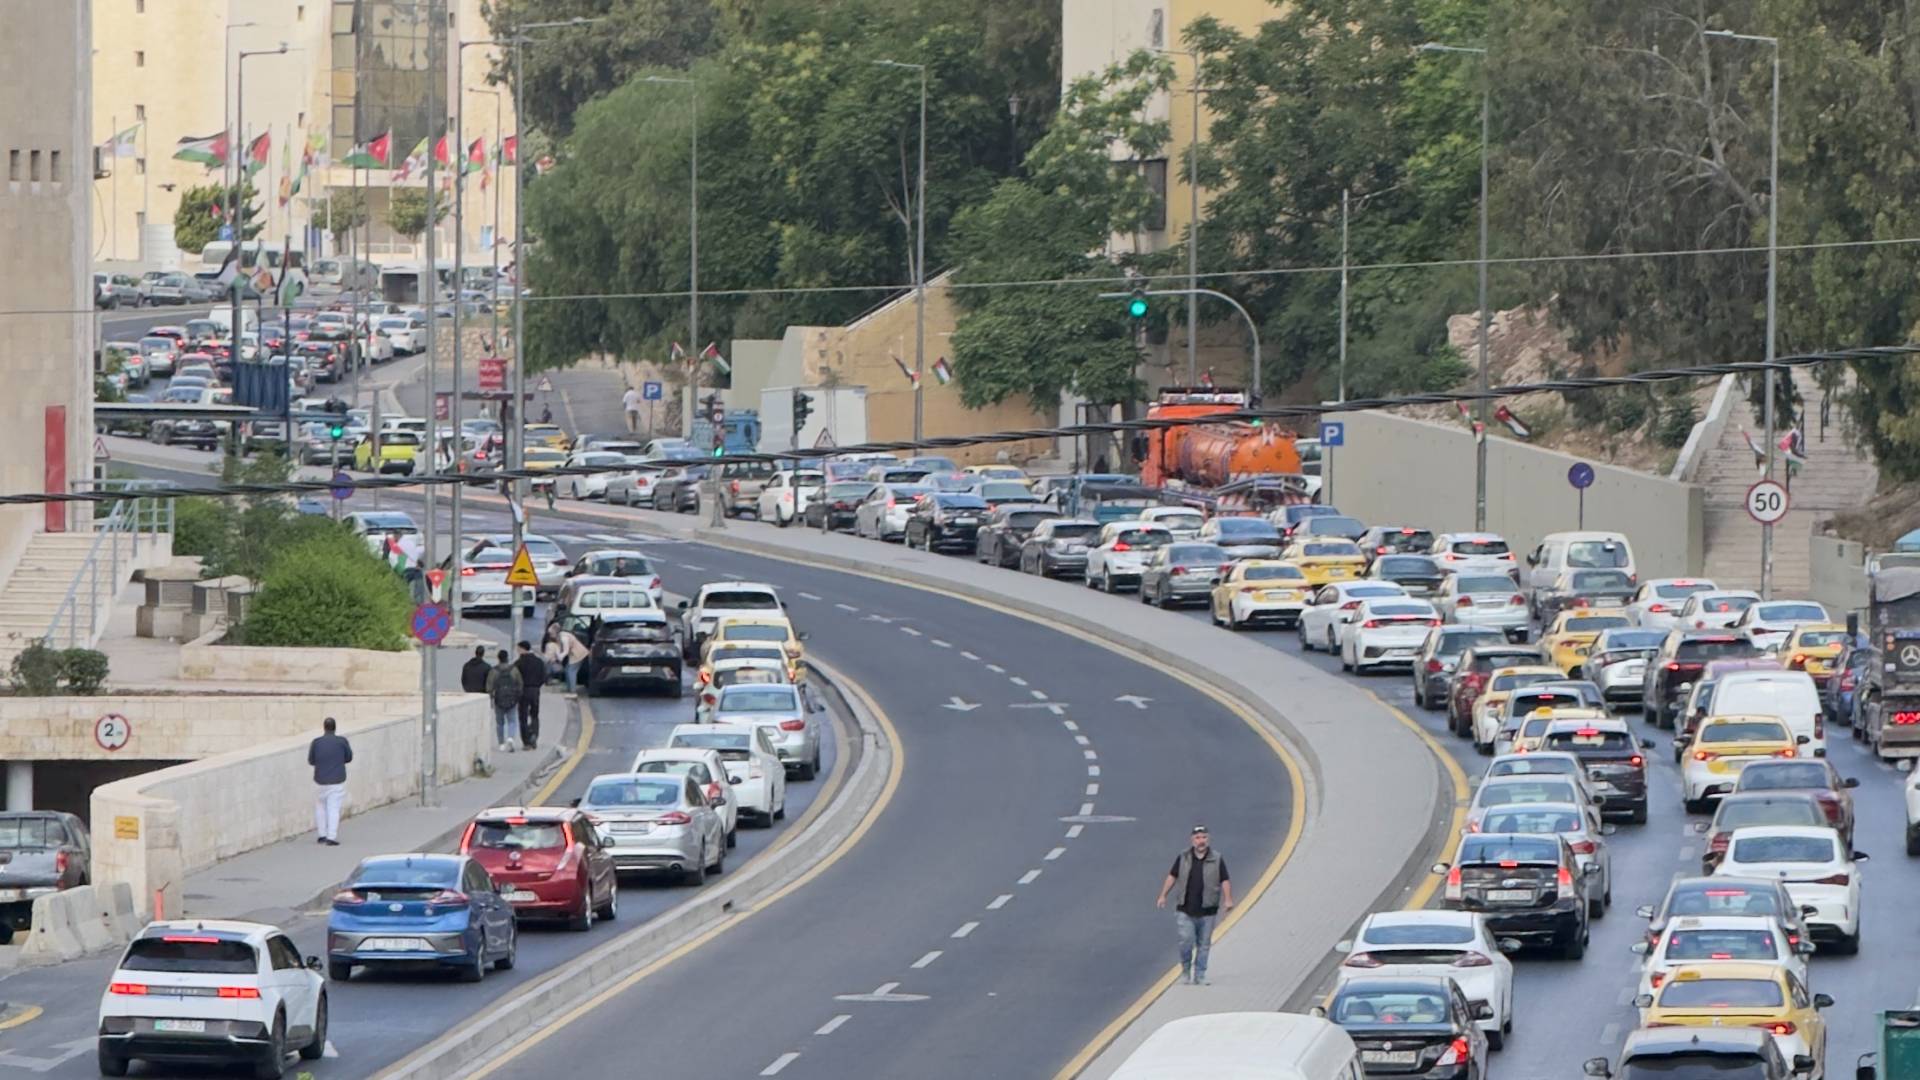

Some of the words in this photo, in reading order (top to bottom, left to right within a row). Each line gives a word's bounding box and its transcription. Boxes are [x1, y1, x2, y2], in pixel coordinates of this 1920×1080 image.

[646, 384, 658, 397] P
[1325, 425, 1339, 443] P
[1754, 491, 1781, 512] 50
[104, 723, 114, 736] 2
